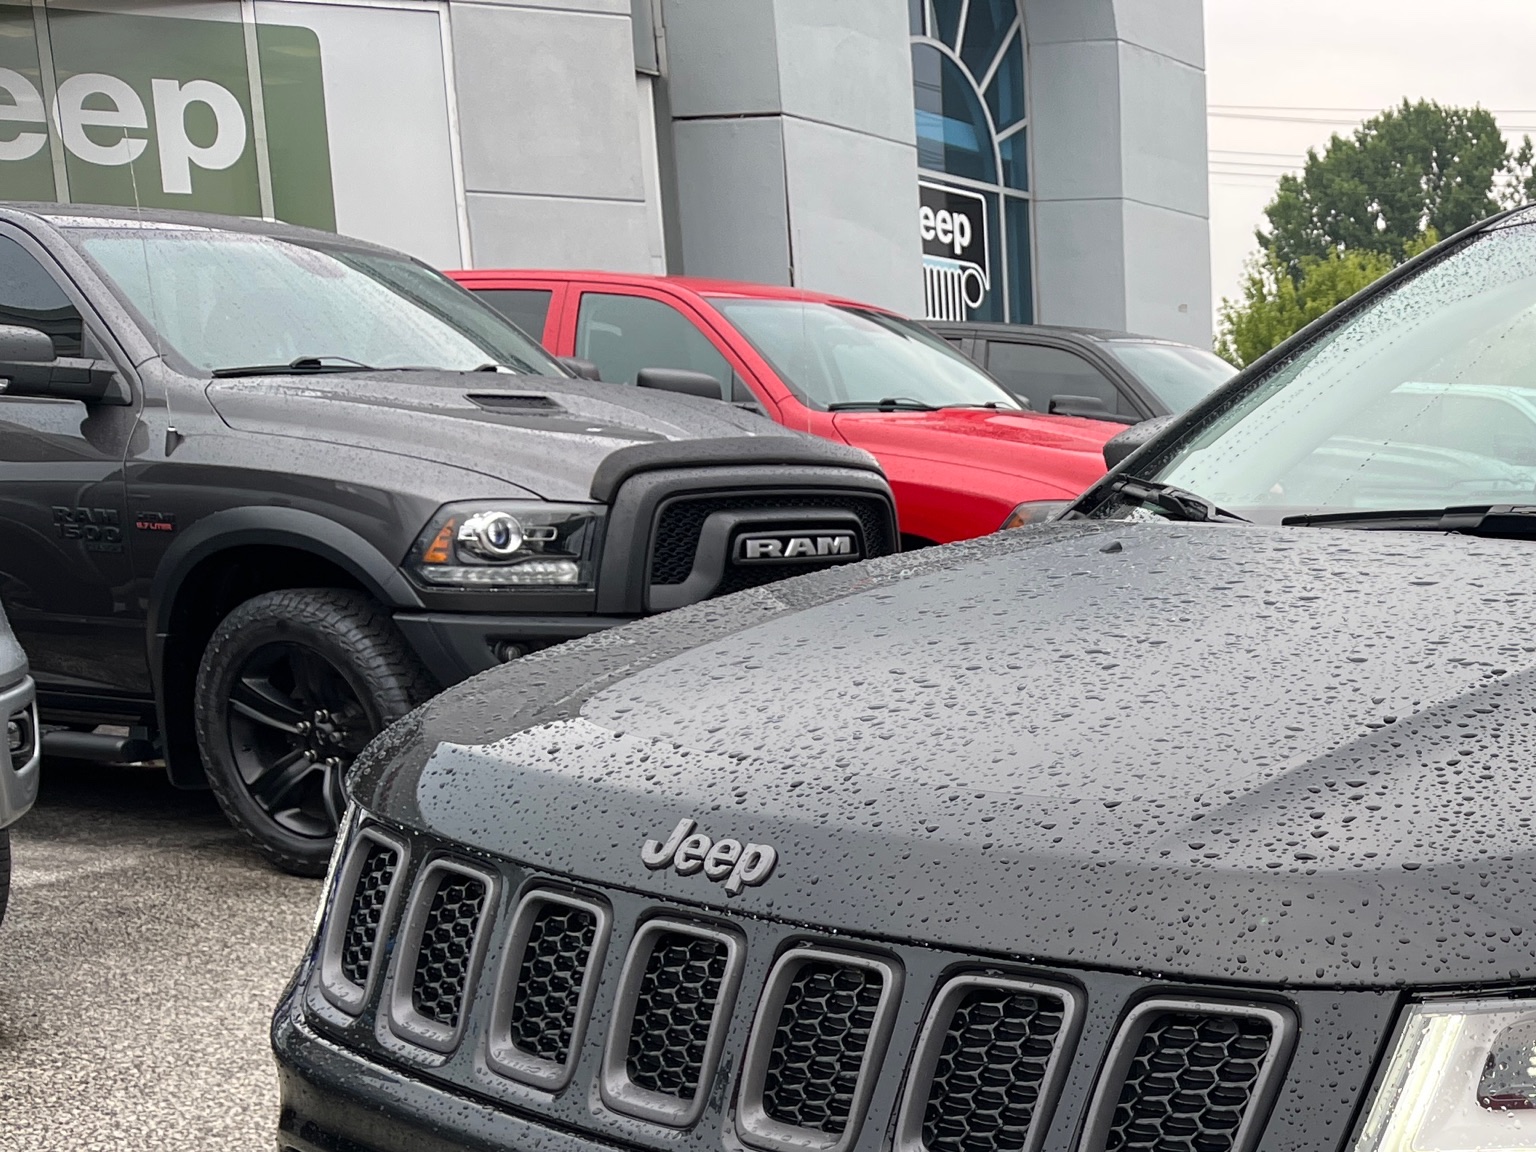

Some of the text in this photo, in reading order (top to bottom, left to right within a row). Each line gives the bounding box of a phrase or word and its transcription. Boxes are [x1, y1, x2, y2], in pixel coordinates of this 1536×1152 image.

[0, 66, 247, 195] eep
[919, 205, 972, 256] eep
[52, 506, 119, 522] RAM
[54, 522, 122, 542] 1500
[746, 536, 851, 558] RAM
[641, 817, 778, 897] Jeep
